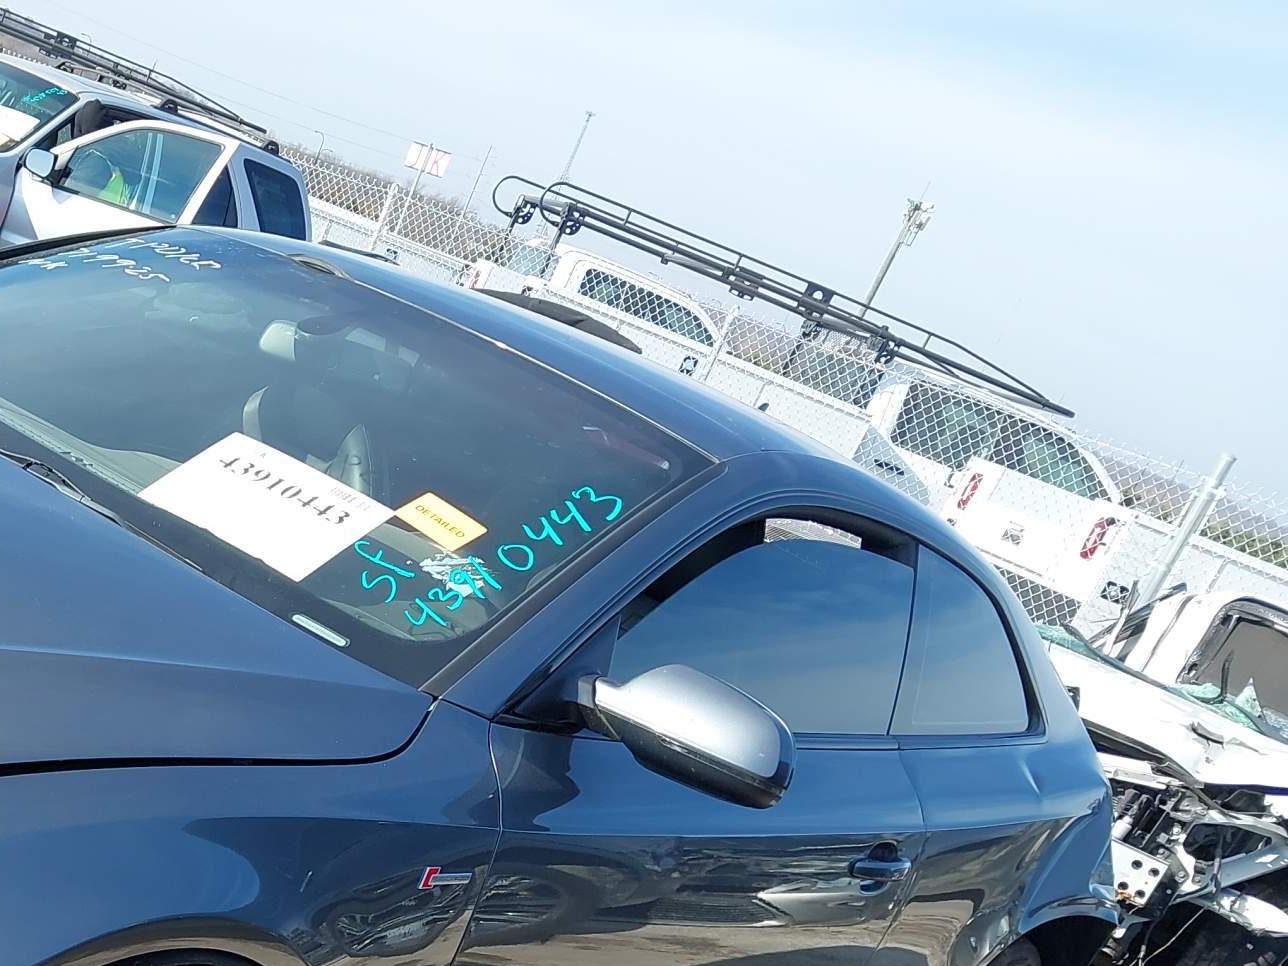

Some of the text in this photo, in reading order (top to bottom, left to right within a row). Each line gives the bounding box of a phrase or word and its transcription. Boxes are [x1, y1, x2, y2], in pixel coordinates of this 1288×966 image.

[218, 454, 354, 527] 43910443
[414, 503, 466, 539] DETAILED
[404, 485, 623, 627] 43910443
